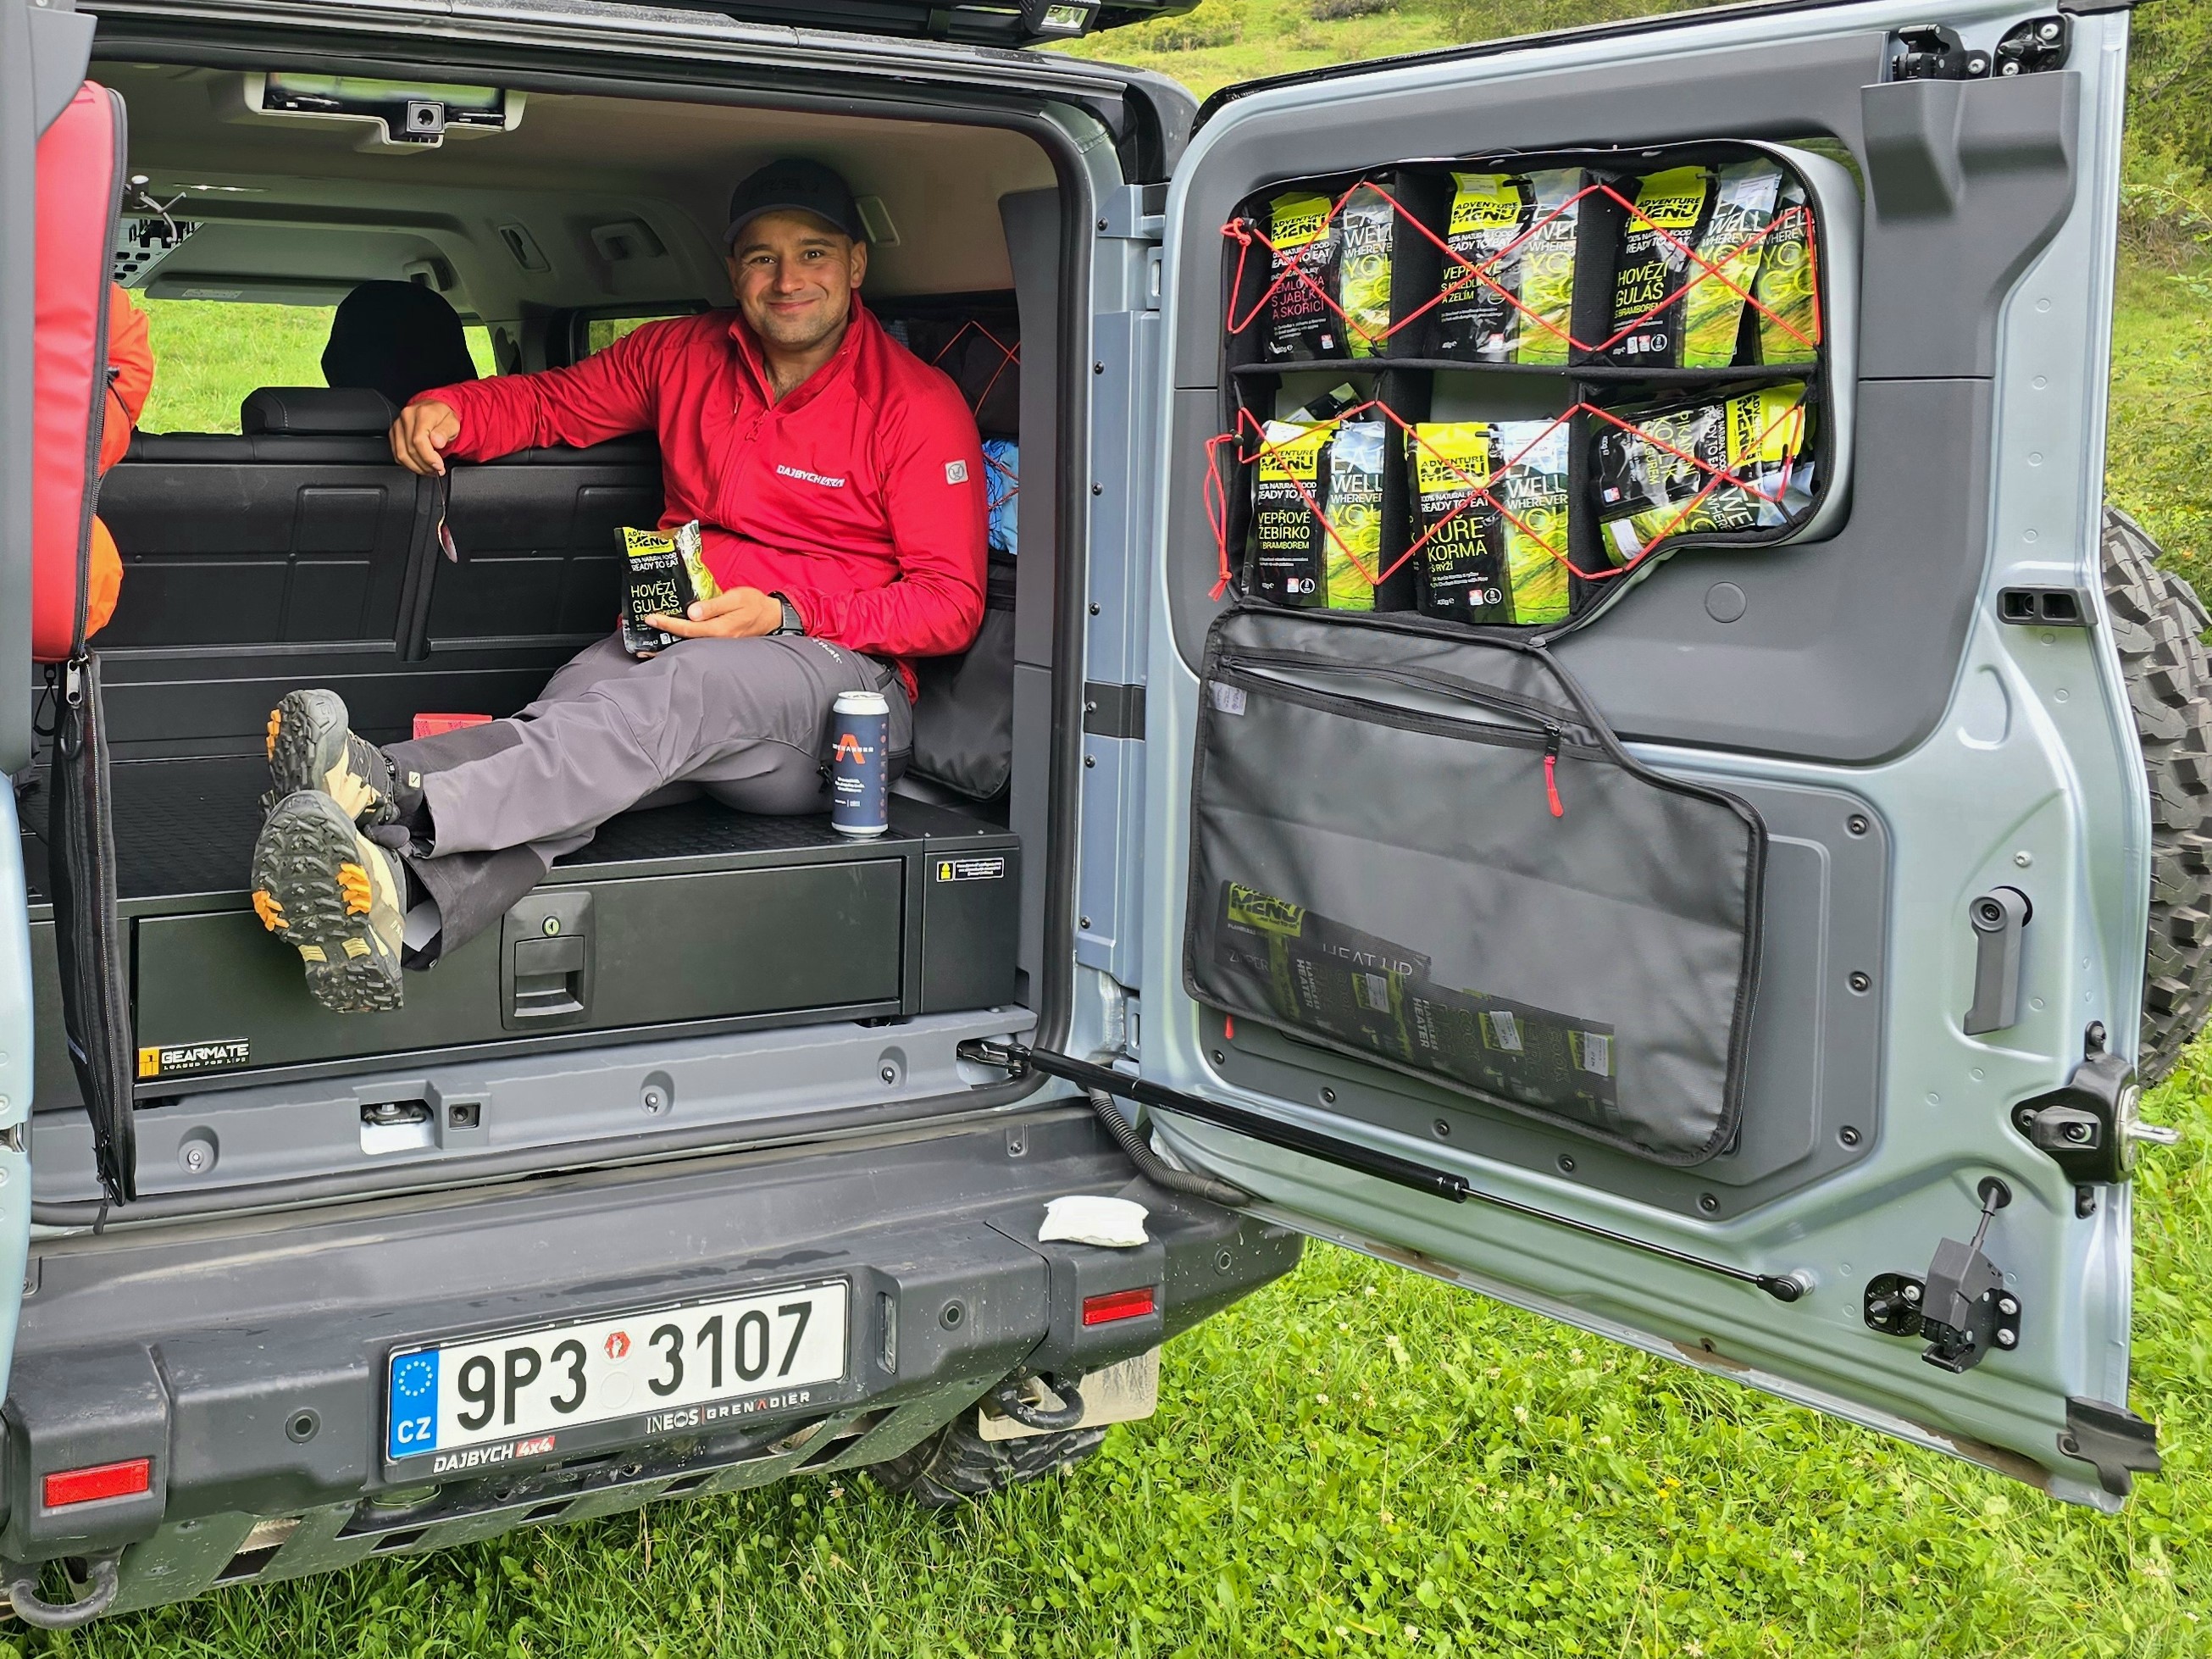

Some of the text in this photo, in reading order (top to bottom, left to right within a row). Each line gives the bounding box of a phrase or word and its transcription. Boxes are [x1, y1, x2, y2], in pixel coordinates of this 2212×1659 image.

[1638, 197, 1701, 208] ADVENTURE
[1453, 208, 1517, 224] MENU
[1617, 258, 1672, 287] HOVĚZÍ
[1450, 291, 1475, 302] ZELÍM
[1616, 278, 1665, 308] GULÁŠ
[1272, 299, 1325, 321] A SKOŘICÍ
[776, 464, 822, 484] DAJBYCH
[1261, 456, 1314, 472] MENU
[1330, 474, 1383, 493] WELL
[1505, 474, 1567, 499] WELL
[1285, 490, 1298, 499] TO
[1421, 501, 1452, 513] READY
[1470, 497, 1489, 508] EAT
[1436, 492, 1466, 501] NATURAL
[1505, 494, 1569, 509] WHEREVER
[1258, 509, 1311, 524] VEPŘOVÉ
[1258, 524, 1311, 540] ŽEBÍRKO
[1423, 513, 1485, 545] KUŘE
[1262, 541, 1310, 550] BRAMBOREM
[1427, 540, 1488, 562] KORMA
[631, 557, 679, 571] READY TO EAT
[630, 579, 677, 598] HOVĚZÍ
[633, 591, 679, 613] GULÁŠ
[1231, 890, 1304, 924] MENU
[1296, 959, 1313, 1008] HEATER
[1306, 961, 1321, 1010] FLAMELESS
[1413, 997, 1430, 1048] HEATER
[1422, 999, 1439, 1051] FLAMELESS
[162, 1043, 249, 1064] GEARMATE
[457, 1301, 812, 1431] 9P3 3107
[645, 1391, 811, 1434] INEOS GRENADIER
[396, 1416, 431, 1444] CZ
[433, 1437, 553, 1473] DAJBYCH 4x4
